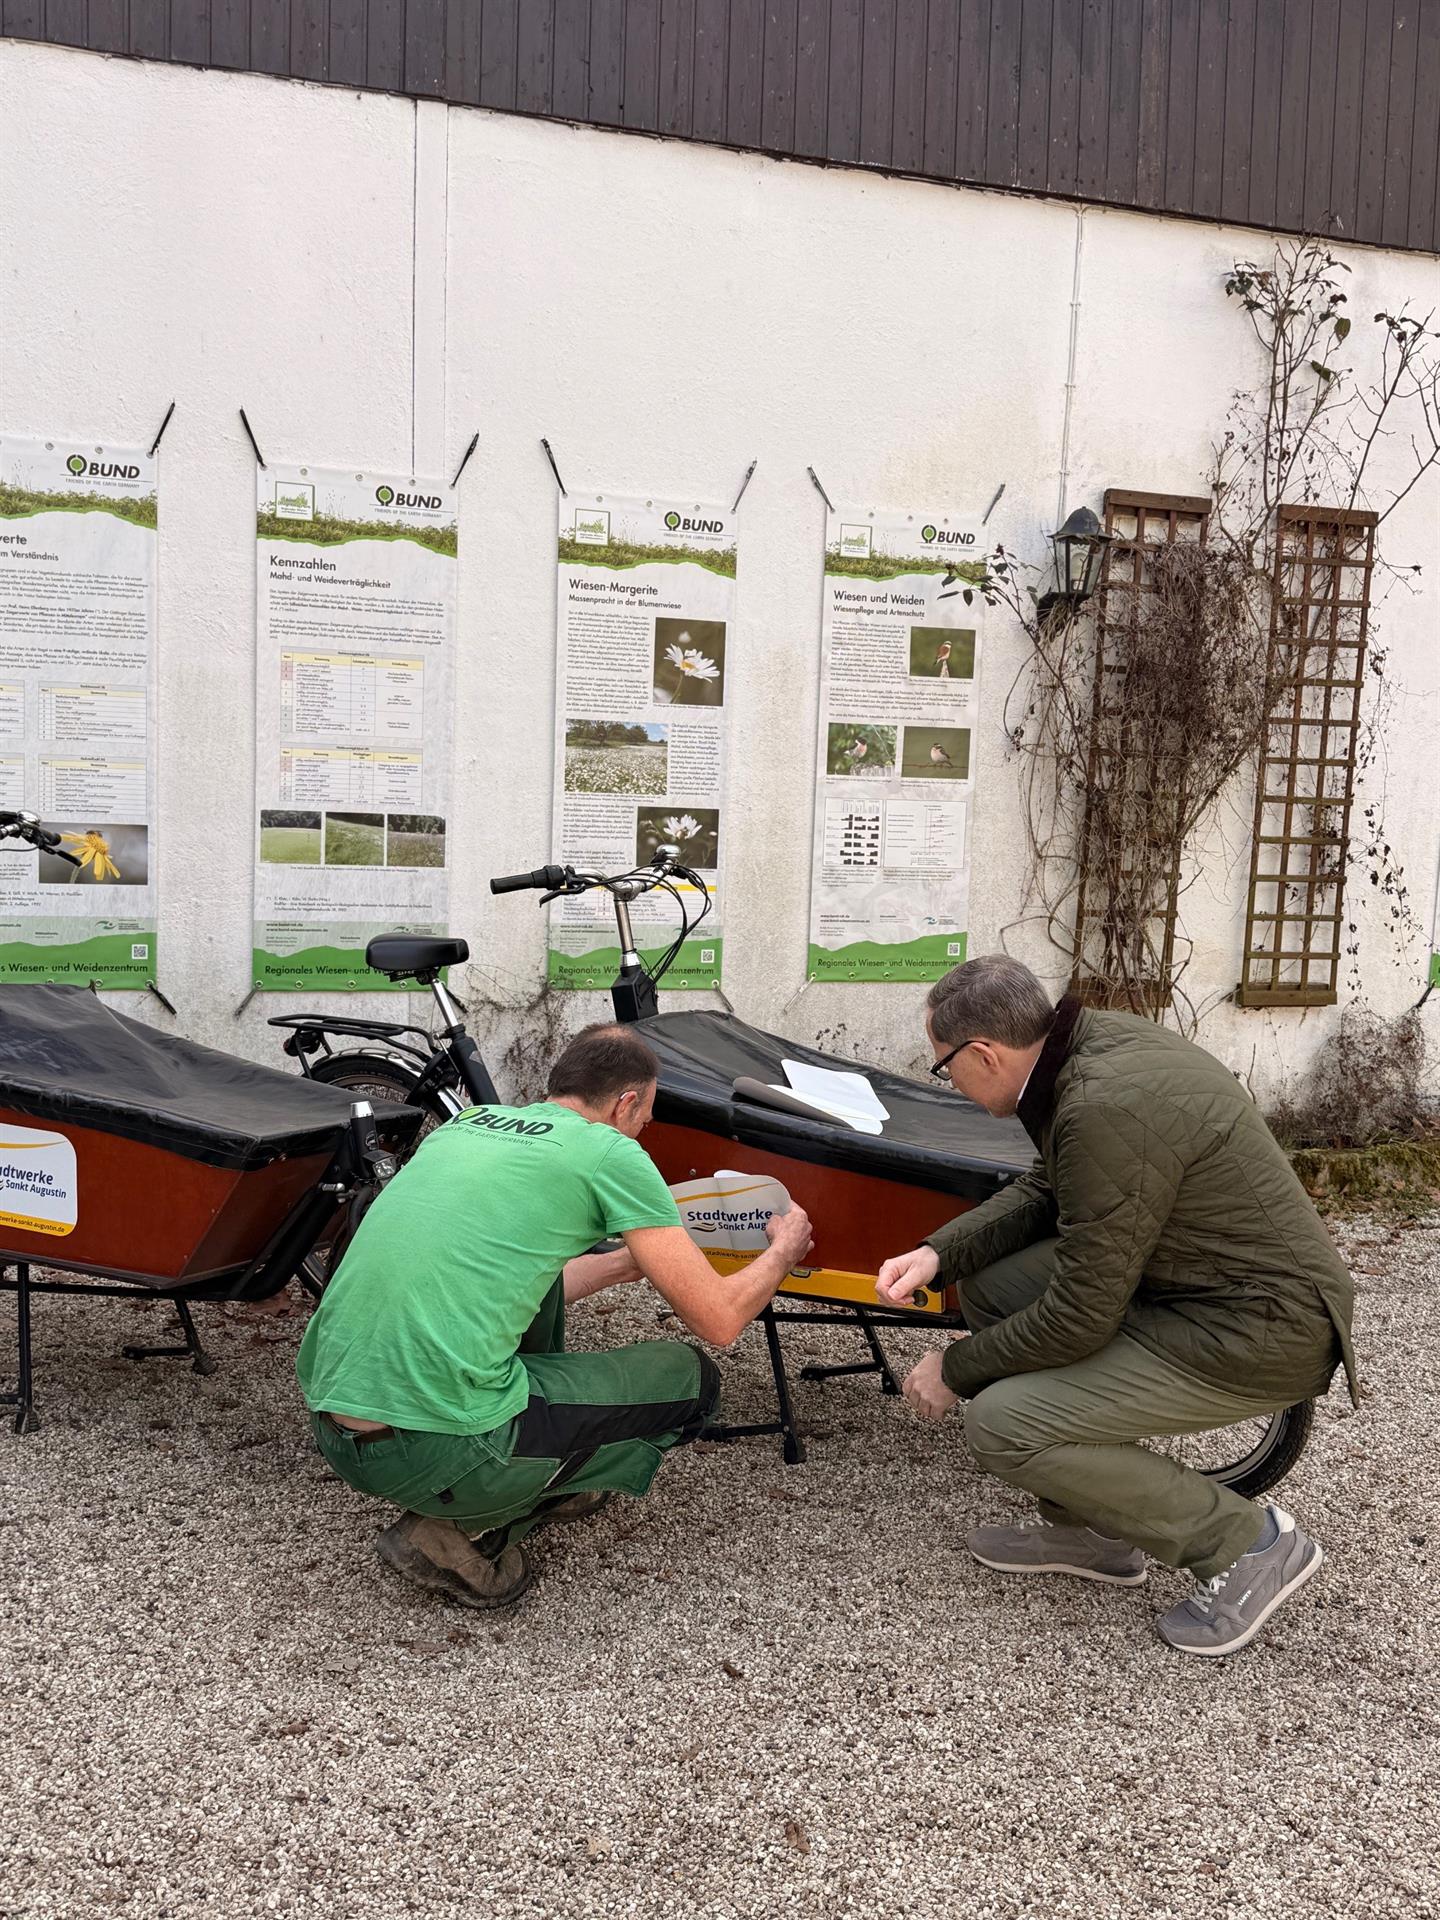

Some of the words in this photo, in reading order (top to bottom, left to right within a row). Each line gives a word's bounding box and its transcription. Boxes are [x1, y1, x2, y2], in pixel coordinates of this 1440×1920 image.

[89, 462, 140, 479] BUND
[395, 493, 442, 509] BUND
[682, 518, 724, 533] BUND
[936, 531, 976, 545] BUND
[10, 550, 59, 562] Verständnis
[270, 555, 336, 571] Kennzahlen
[270, 572, 294, 581] Mahd-
[297, 574, 312, 582] und
[314, 575, 391, 589] Weideverträglichkeit
[569, 578, 658, 597] Wiesen-Margerite
[568, 594, 615, 606] Massenpracht
[617, 598, 624, 606] in
[624, 598, 636, 607] der
[638, 600, 682, 610] Blumenwiese
[834, 590, 867, 603] Wiesen
[870, 593, 888, 604] und
[890, 593, 925, 606] Weiden
[833, 605, 874, 616] Wiesenpflege
[876, 608, 888, 616] und
[890, 608, 925, 618] Artenschutz
[8, 963, 48, 973] Wiesen-
[52, 963, 70, 973] und
[74, 963, 148, 973] Weidenzentrum
[264, 965, 313, 976] Regionales
[316, 966, 352, 975] Wiesen-
[354, 966, 370, 975] und
[818, 958, 856, 969] Regionales
[858, 958, 888, 968] Wiesen-
[889, 959, 903, 968] und
[904, 958, 960, 969] Weidenzentrum
[558, 966, 602, 977] Regionales
[470, 1113, 554, 1136] BUND
[6, 1179, 28, 1192] Sankt
[30, 1184, 67, 1199] Augustin
[688, 1208, 773, 1222] Stadtwerke
[718, 1222, 745, 1232] Sankt
